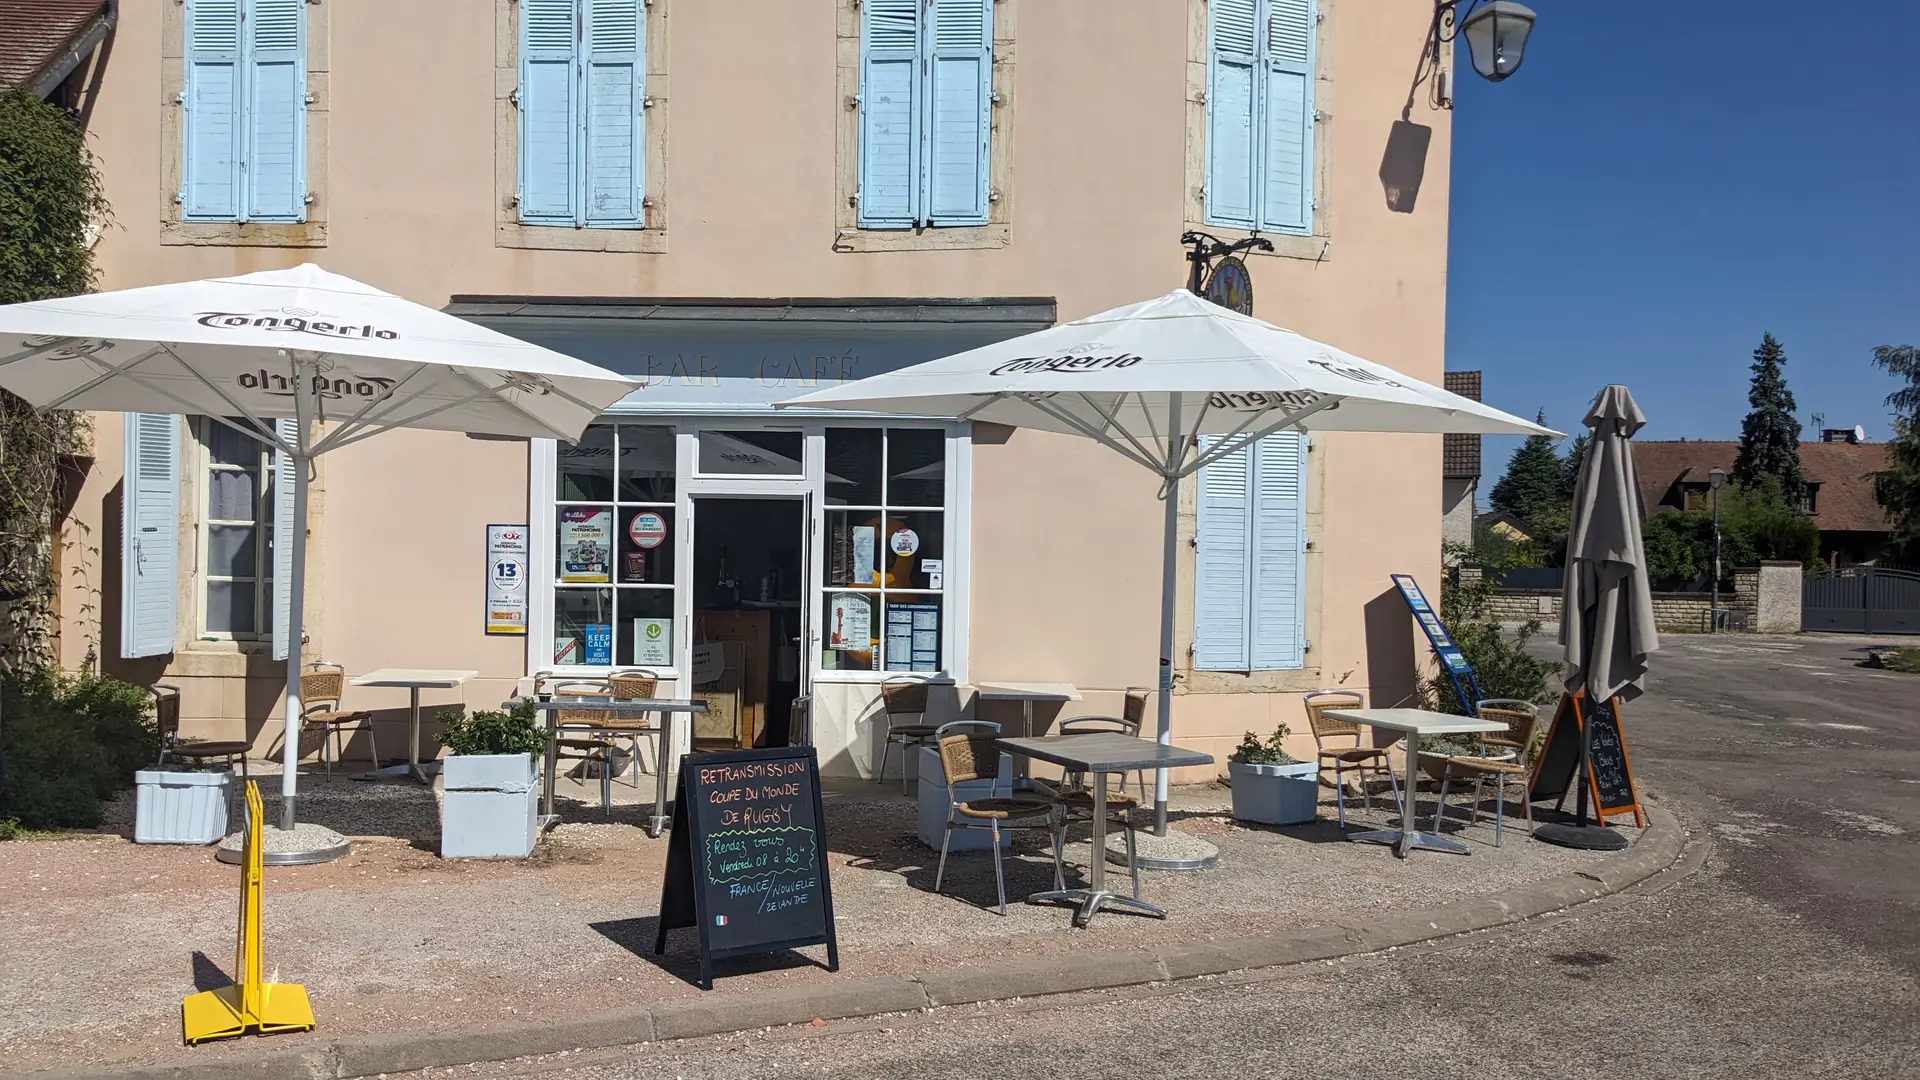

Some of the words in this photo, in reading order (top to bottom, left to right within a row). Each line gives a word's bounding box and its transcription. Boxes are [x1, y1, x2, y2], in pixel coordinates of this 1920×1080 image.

[193, 311, 402, 340] Tongerlo
[641, 354, 722, 388] BAR
[756, 349, 860, 389] CAFÉ
[989, 352, 1143, 376] Tongerlo
[497, 564, 516, 577] 13
[556, 642, 575, 661] LICENCE
[701, 761, 804, 785] RETRANSMISSION
[710, 789, 741, 803] COUPE
[745, 788, 758, 800] DU
[762, 783, 799, 799] MONDE
[721, 810, 739, 825] DE
[744, 804, 792, 829] RUGBY
[714, 839, 746, 858] Rendez
[753, 837, 784, 848] vous
[720, 858, 753, 873] Vendredi
[756, 854, 767, 867] 08
[774, 852, 779, 863] à
[766, 894, 808, 912] ZELANDE
